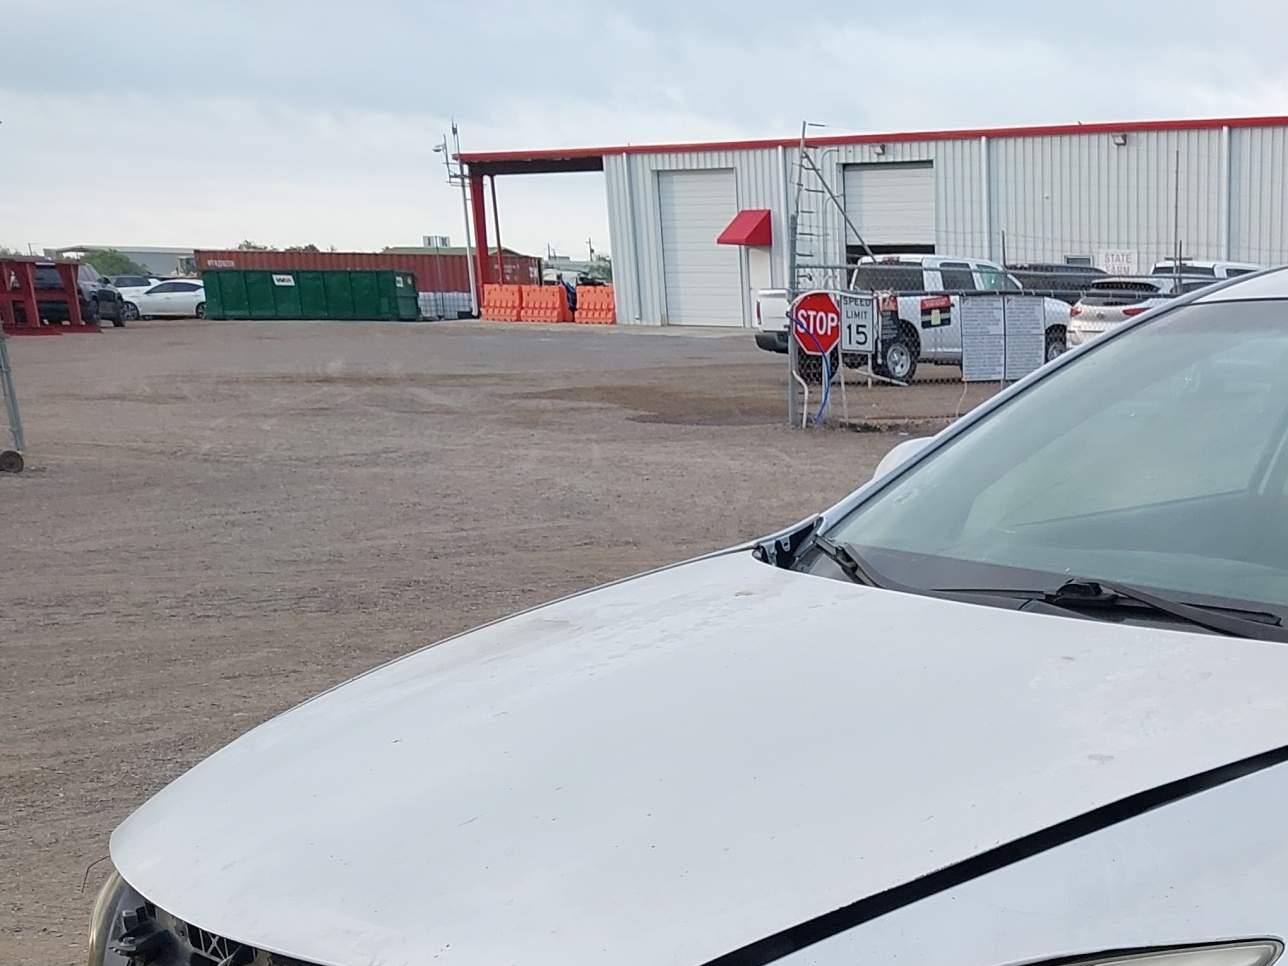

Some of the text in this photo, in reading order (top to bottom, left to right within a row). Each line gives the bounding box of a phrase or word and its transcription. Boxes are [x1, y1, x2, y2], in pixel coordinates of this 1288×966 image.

[1104, 252, 1132, 264] STATE
[843, 296, 871, 307] SPEED
[846, 310, 868, 320] LIMIT
[797, 309, 839, 336] STOP
[847, 324, 867, 345] 15
